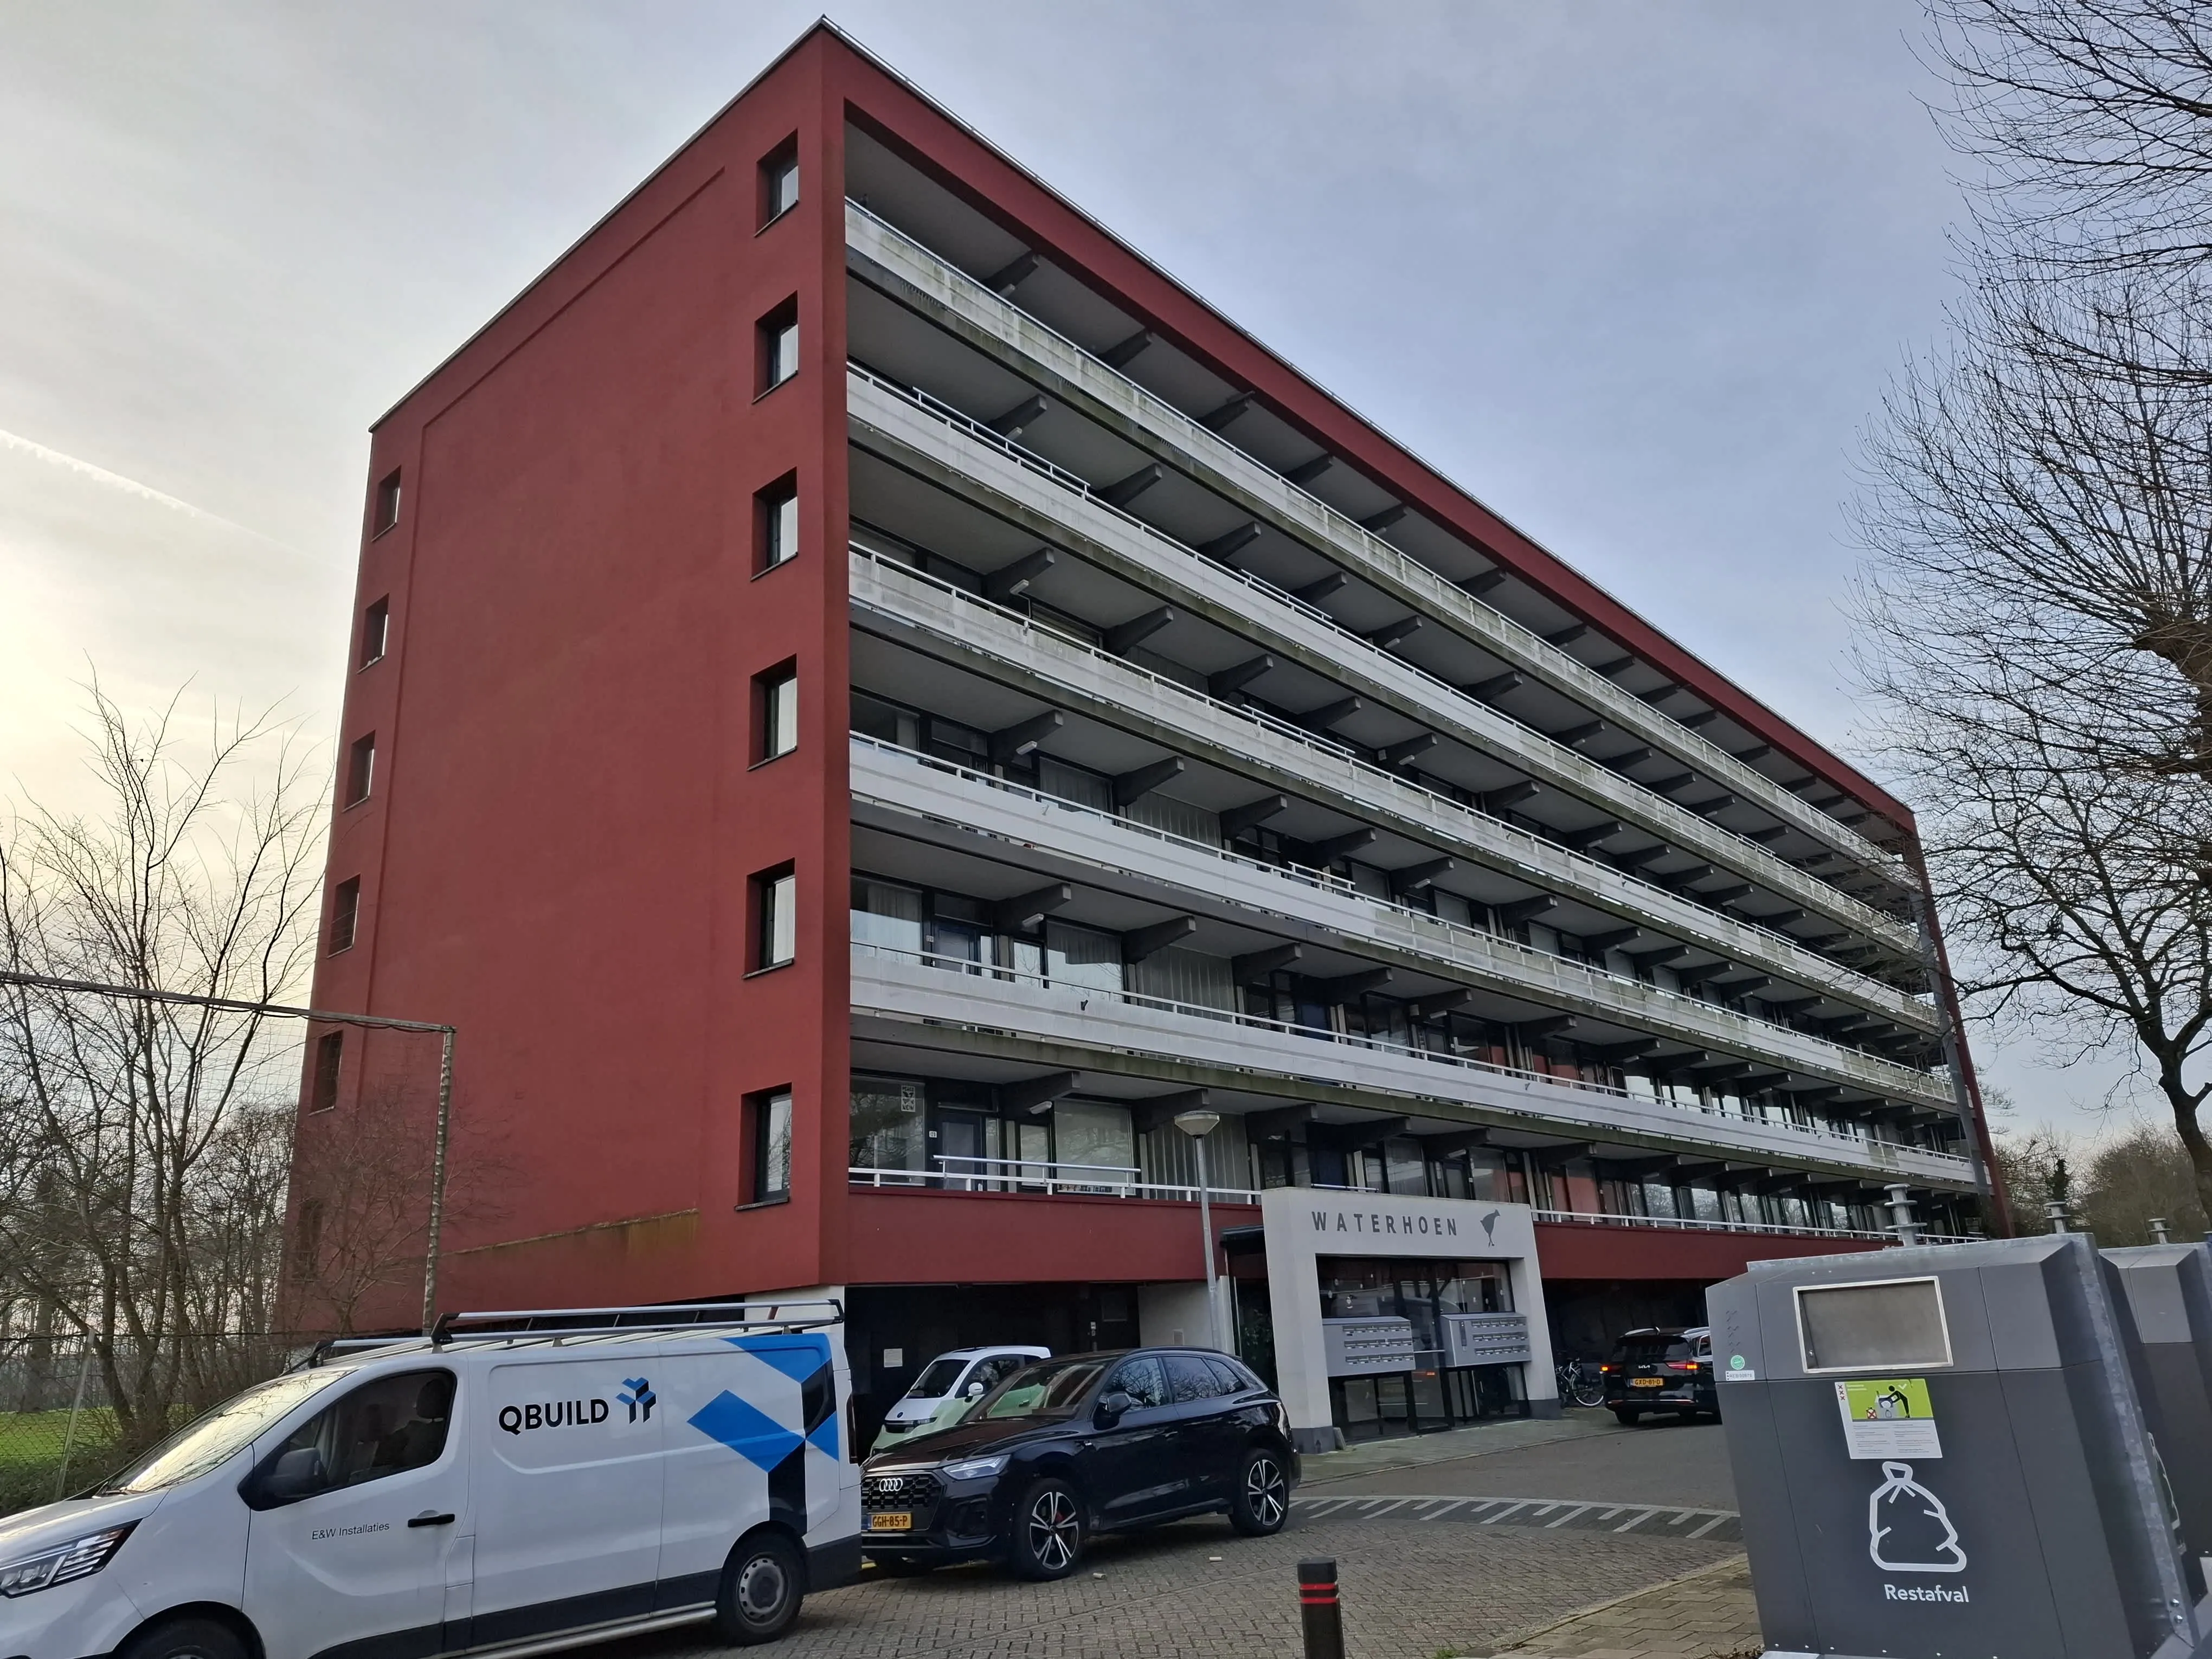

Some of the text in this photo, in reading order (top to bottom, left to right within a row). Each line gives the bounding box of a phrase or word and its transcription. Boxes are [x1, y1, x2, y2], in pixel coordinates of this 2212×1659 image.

[1311, 1211, 1457, 1236] WATERHOEN
[499, 1399, 609, 1436] QBUILD
[872, 1515, 908, 1527] GGH-85-P
[312, 1522, 390, 1540] E&W Installaties
[1884, 1584, 1969, 1603] Restafval
